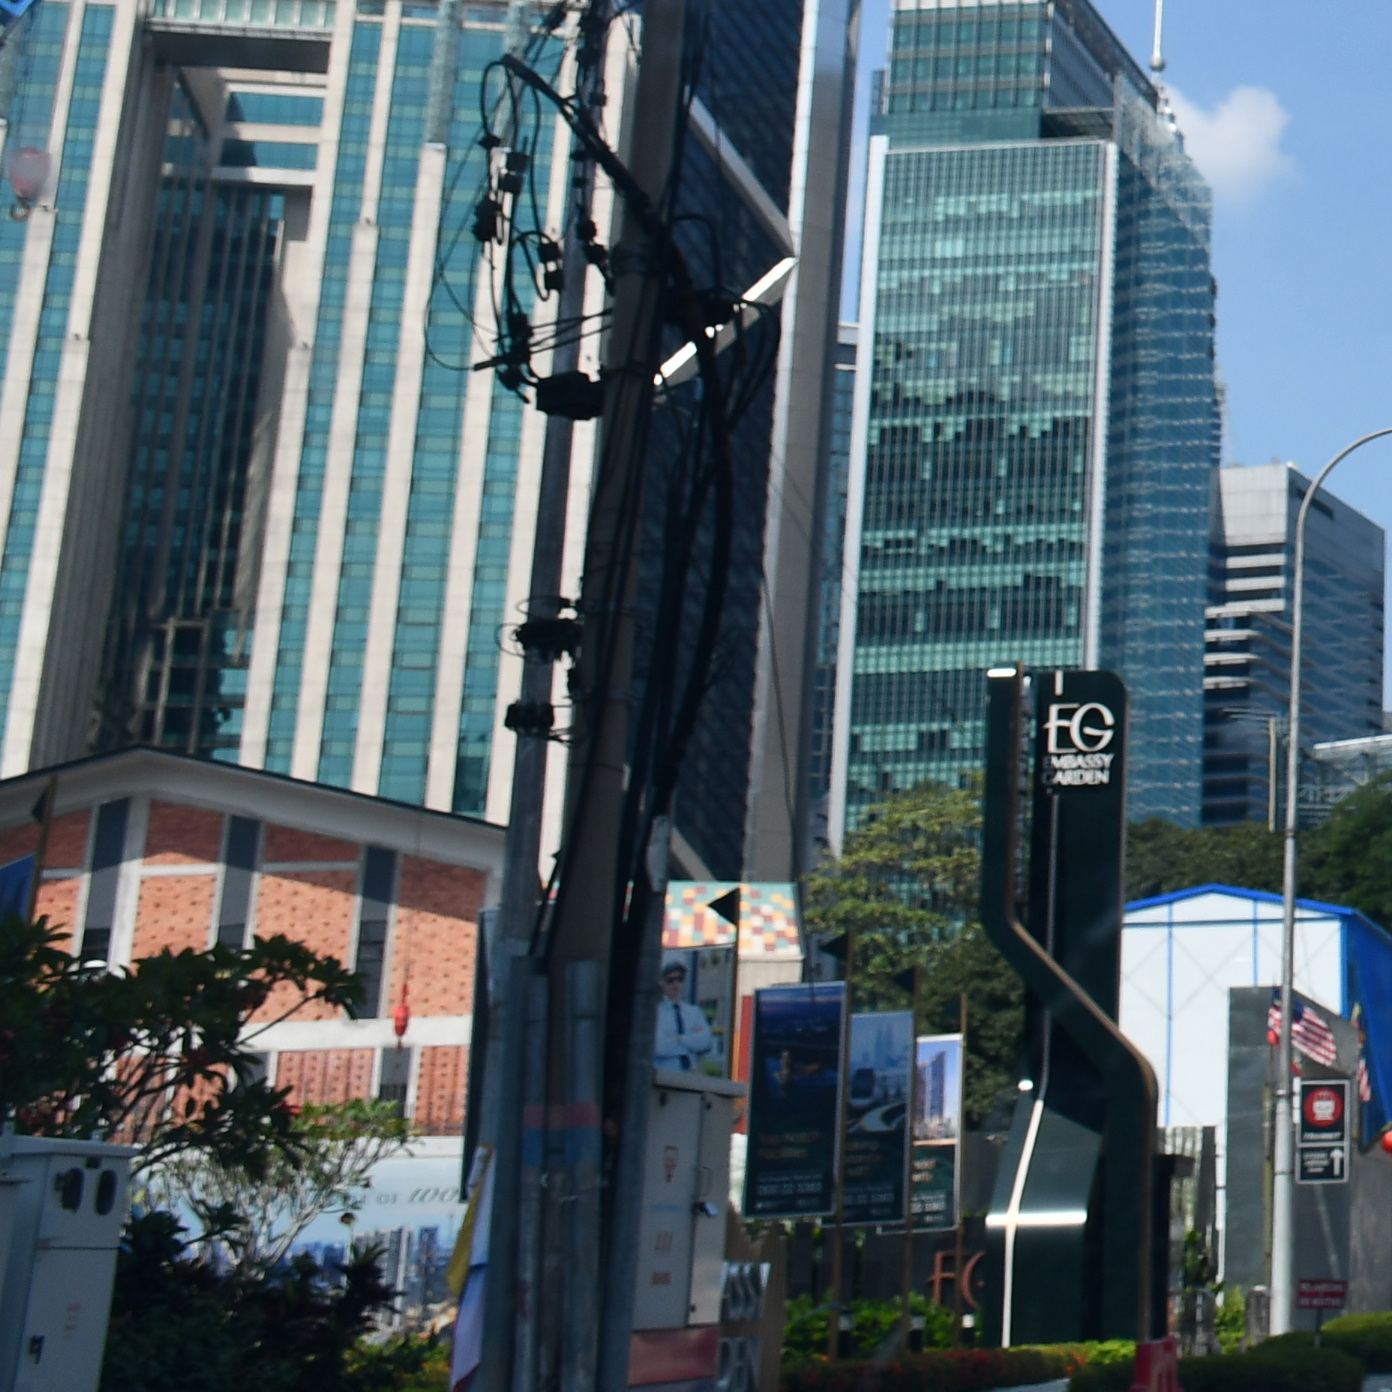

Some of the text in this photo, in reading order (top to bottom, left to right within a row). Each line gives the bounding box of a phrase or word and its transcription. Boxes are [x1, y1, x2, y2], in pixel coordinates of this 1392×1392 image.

[1043, 702, 1115, 754] EG
[1042, 753, 1115, 769] EMBASSY
[1042, 768, 1110, 786] GARDEN
